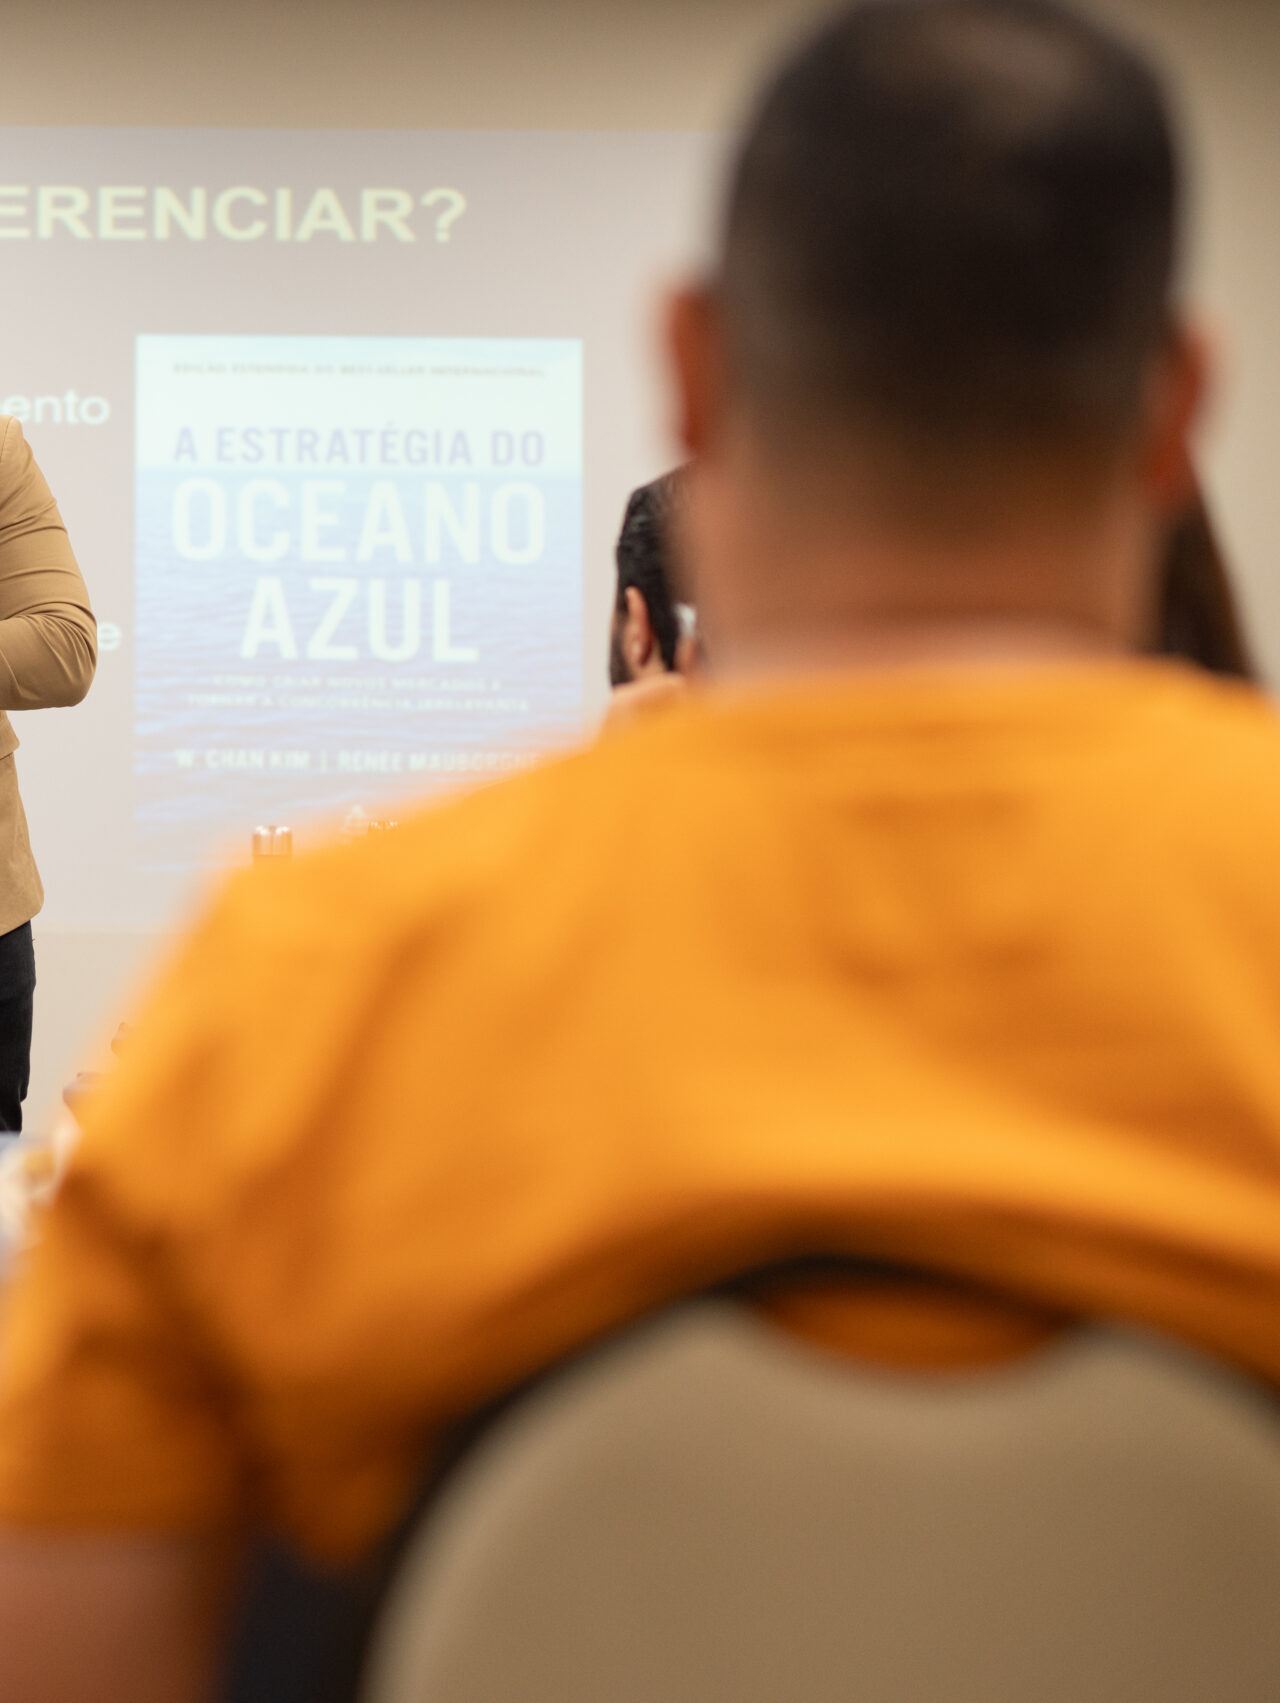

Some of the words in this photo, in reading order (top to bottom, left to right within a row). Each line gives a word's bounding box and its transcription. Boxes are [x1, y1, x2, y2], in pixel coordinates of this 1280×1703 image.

[174, 427, 198, 464] A
[216, 421, 474, 465] ESTRATÉGIA
[490, 430, 545, 467] DO
[172, 477, 546, 565] OCEANO
[239, 577, 480, 662] AZUL
[205, 749, 263, 771] CHAN
[270, 750, 311, 771] KIM
